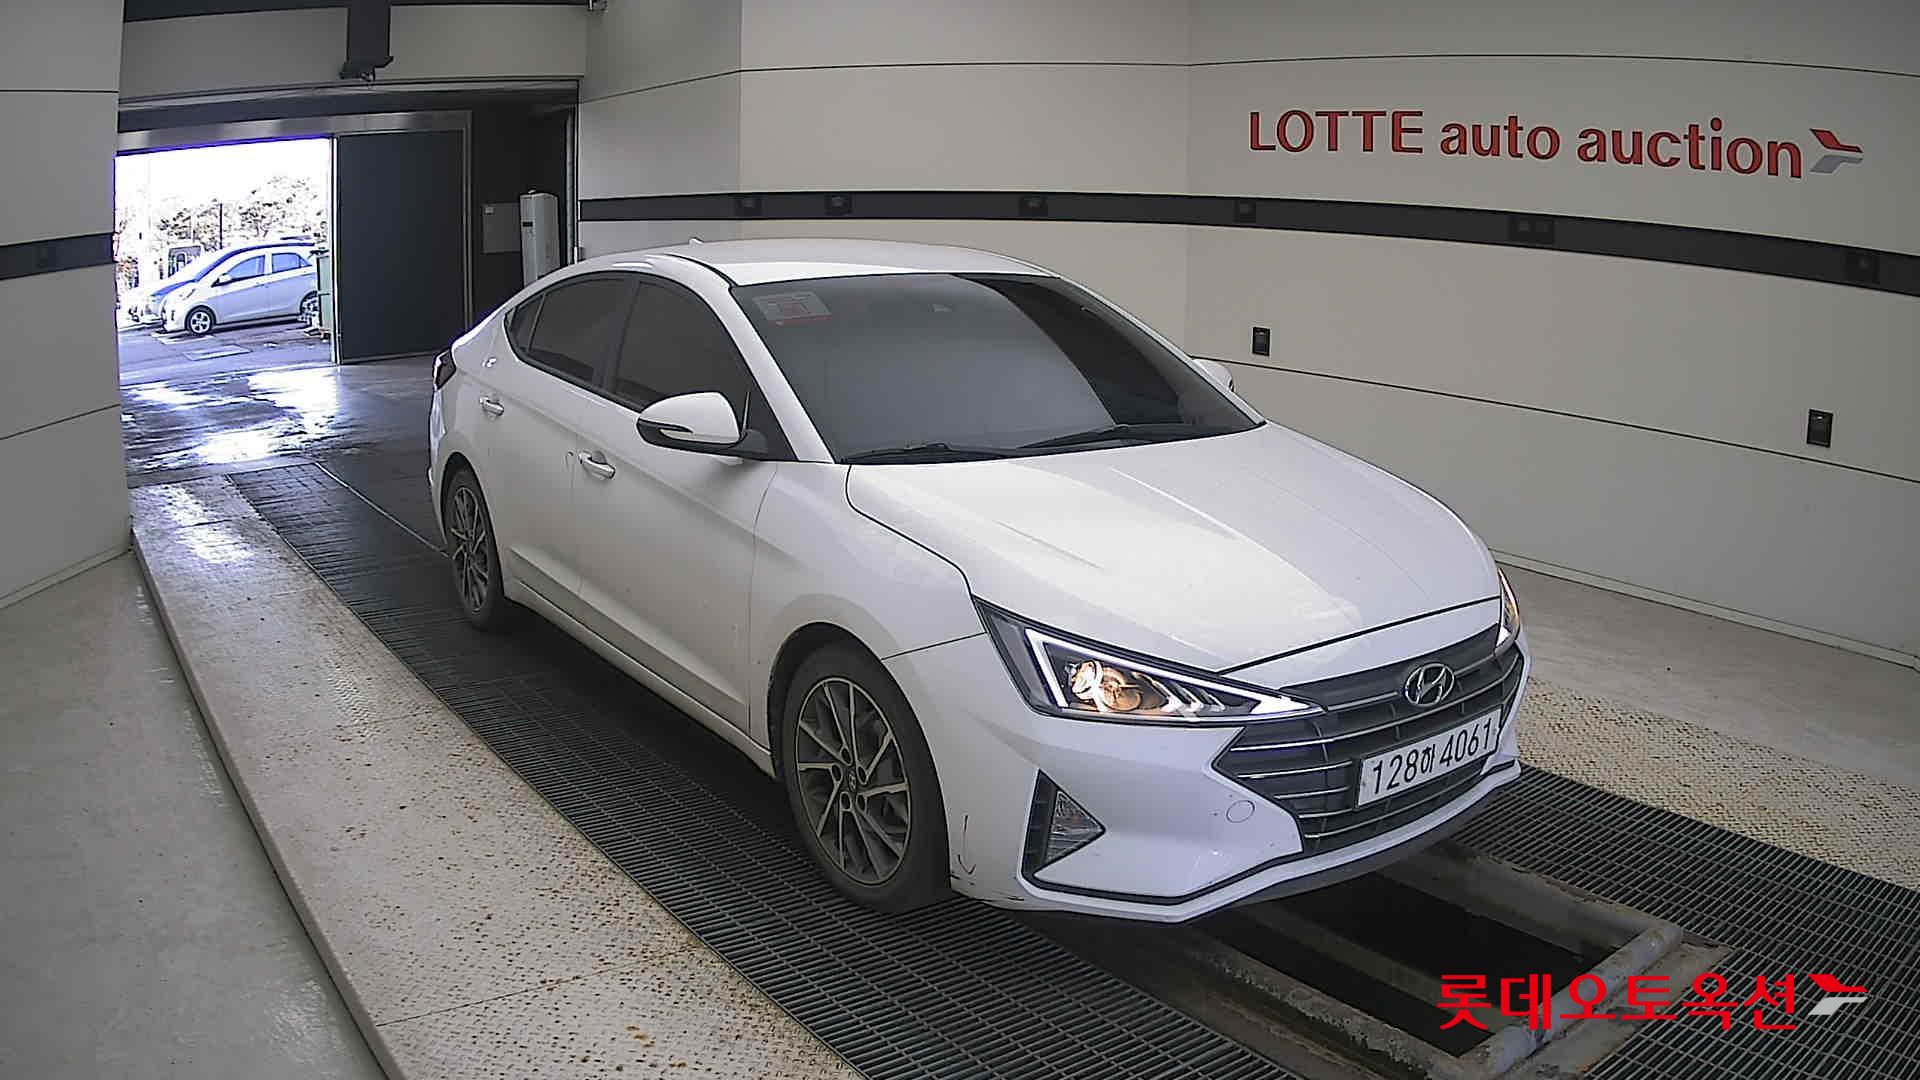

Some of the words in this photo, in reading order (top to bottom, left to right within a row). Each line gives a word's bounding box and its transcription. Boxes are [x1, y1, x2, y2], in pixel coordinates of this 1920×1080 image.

[1249, 110, 1424, 153] LOTTE
[1439, 116, 1560, 160] auto
[1577, 118, 1802, 178] auction
[1372, 744, 1436, 794] 128하
[1439, 718, 1492, 767] 4061
